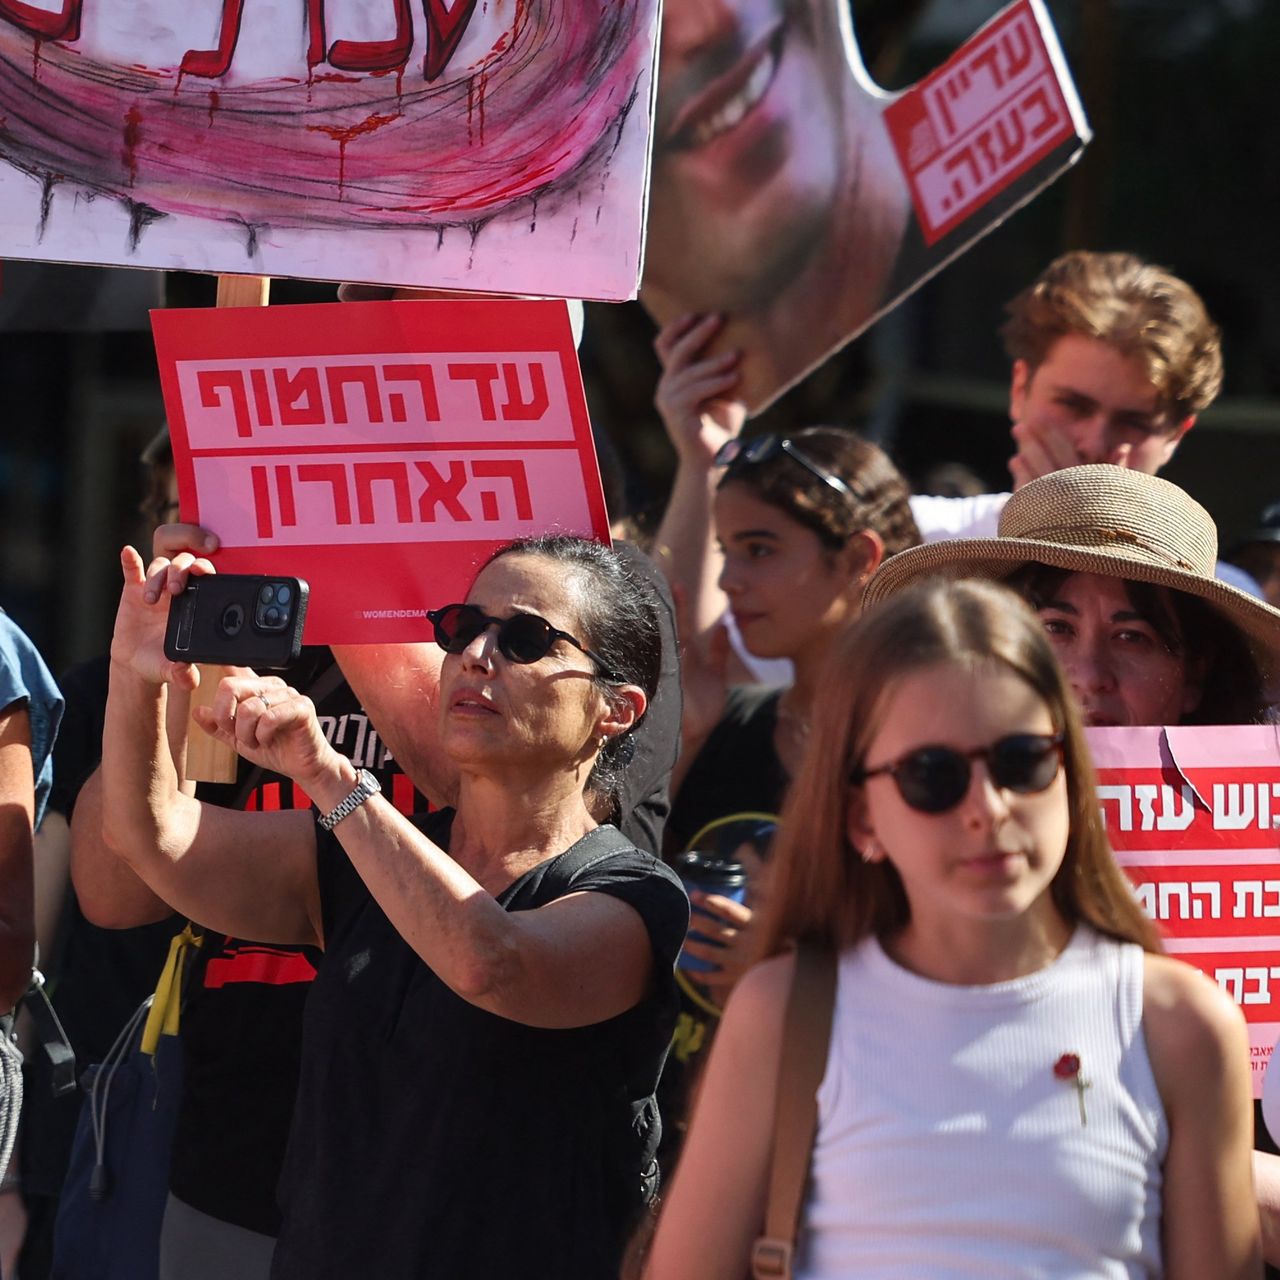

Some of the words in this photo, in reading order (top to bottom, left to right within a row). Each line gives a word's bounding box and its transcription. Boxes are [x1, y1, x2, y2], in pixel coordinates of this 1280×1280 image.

[933, 22, 1034, 137] עדיין
[941, 86, 1060, 211] בעזה.
[196, 364, 441, 438] החטוף
[447, 362, 550, 421] עד
[250, 459, 534, 539] האחרון
[362, 609, 428, 619] WOMENDEMA
[1213, 783, 1280, 830] וש
